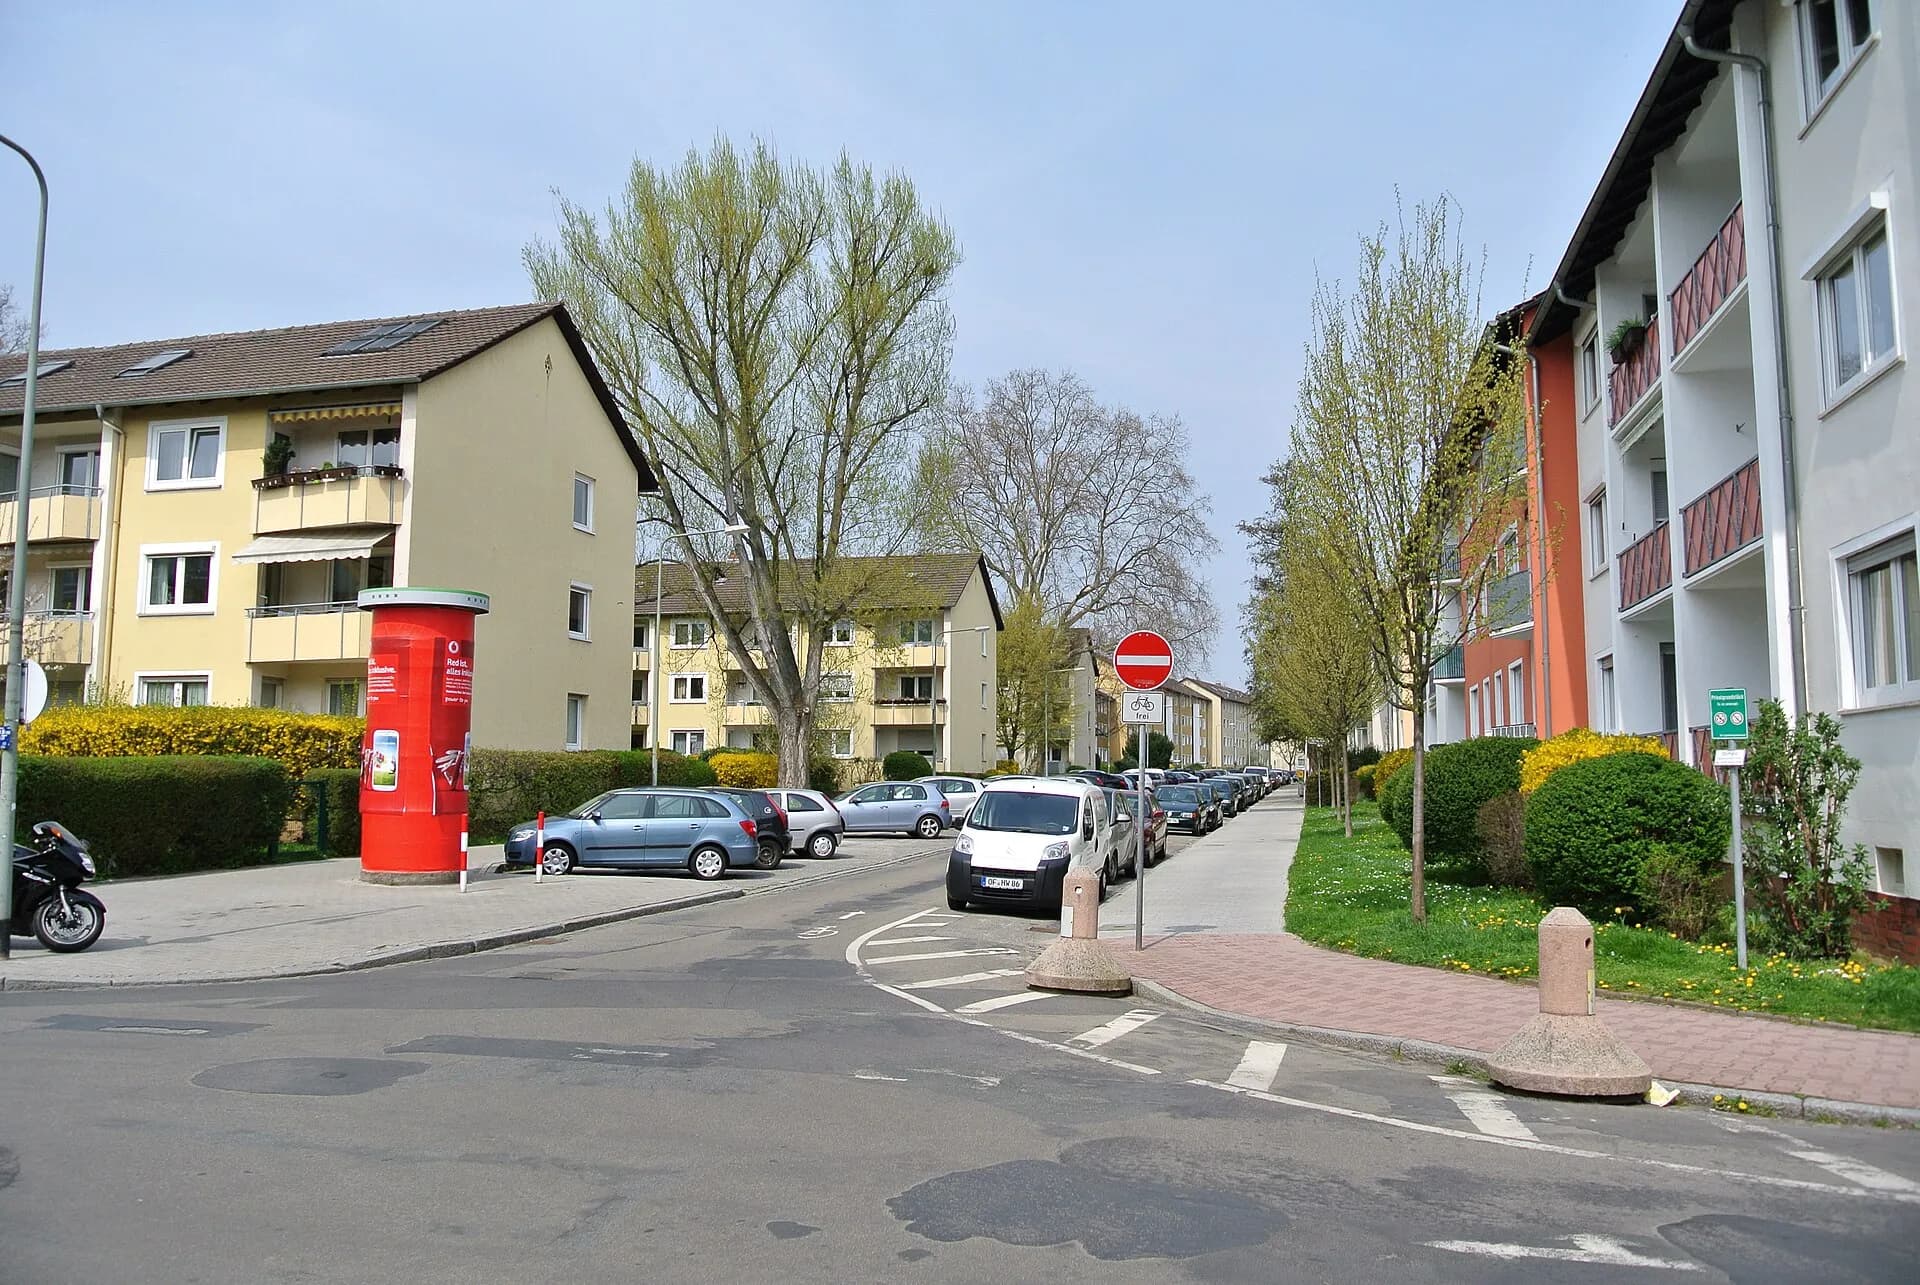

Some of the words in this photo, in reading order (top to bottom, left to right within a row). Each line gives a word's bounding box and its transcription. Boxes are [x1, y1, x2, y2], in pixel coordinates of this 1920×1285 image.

[447, 658, 459, 667] Red
[1136, 712, 1149, 720] frei
[988, 878, 997, 886] OF
